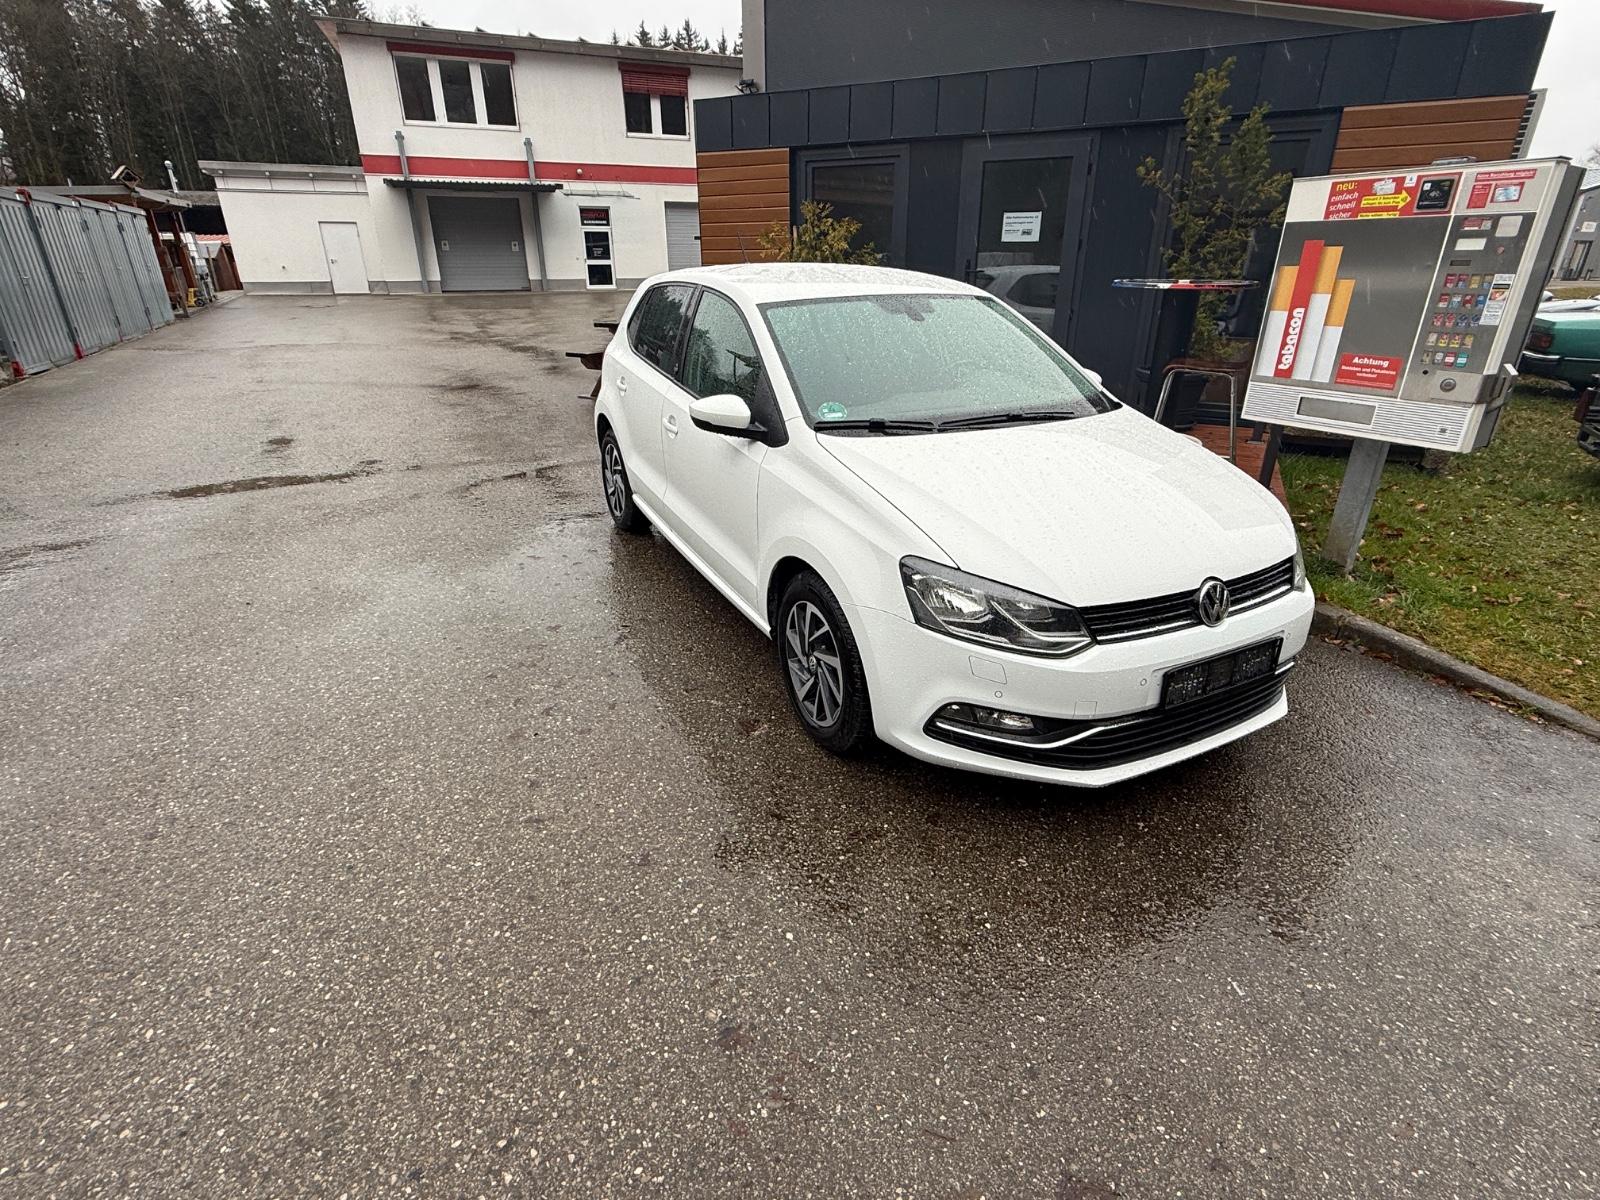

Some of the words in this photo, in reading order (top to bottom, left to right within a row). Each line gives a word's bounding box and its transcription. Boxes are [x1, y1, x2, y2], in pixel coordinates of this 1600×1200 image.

[1337, 182, 1358, 191] neu:
[1331, 192, 1359, 202] einfach
[1329, 201, 1356, 211] schnell
[1328, 211, 1352, 220] sicher
[1277, 307, 1306, 370] tabacon
[1352, 356, 1390, 368] Achtung
